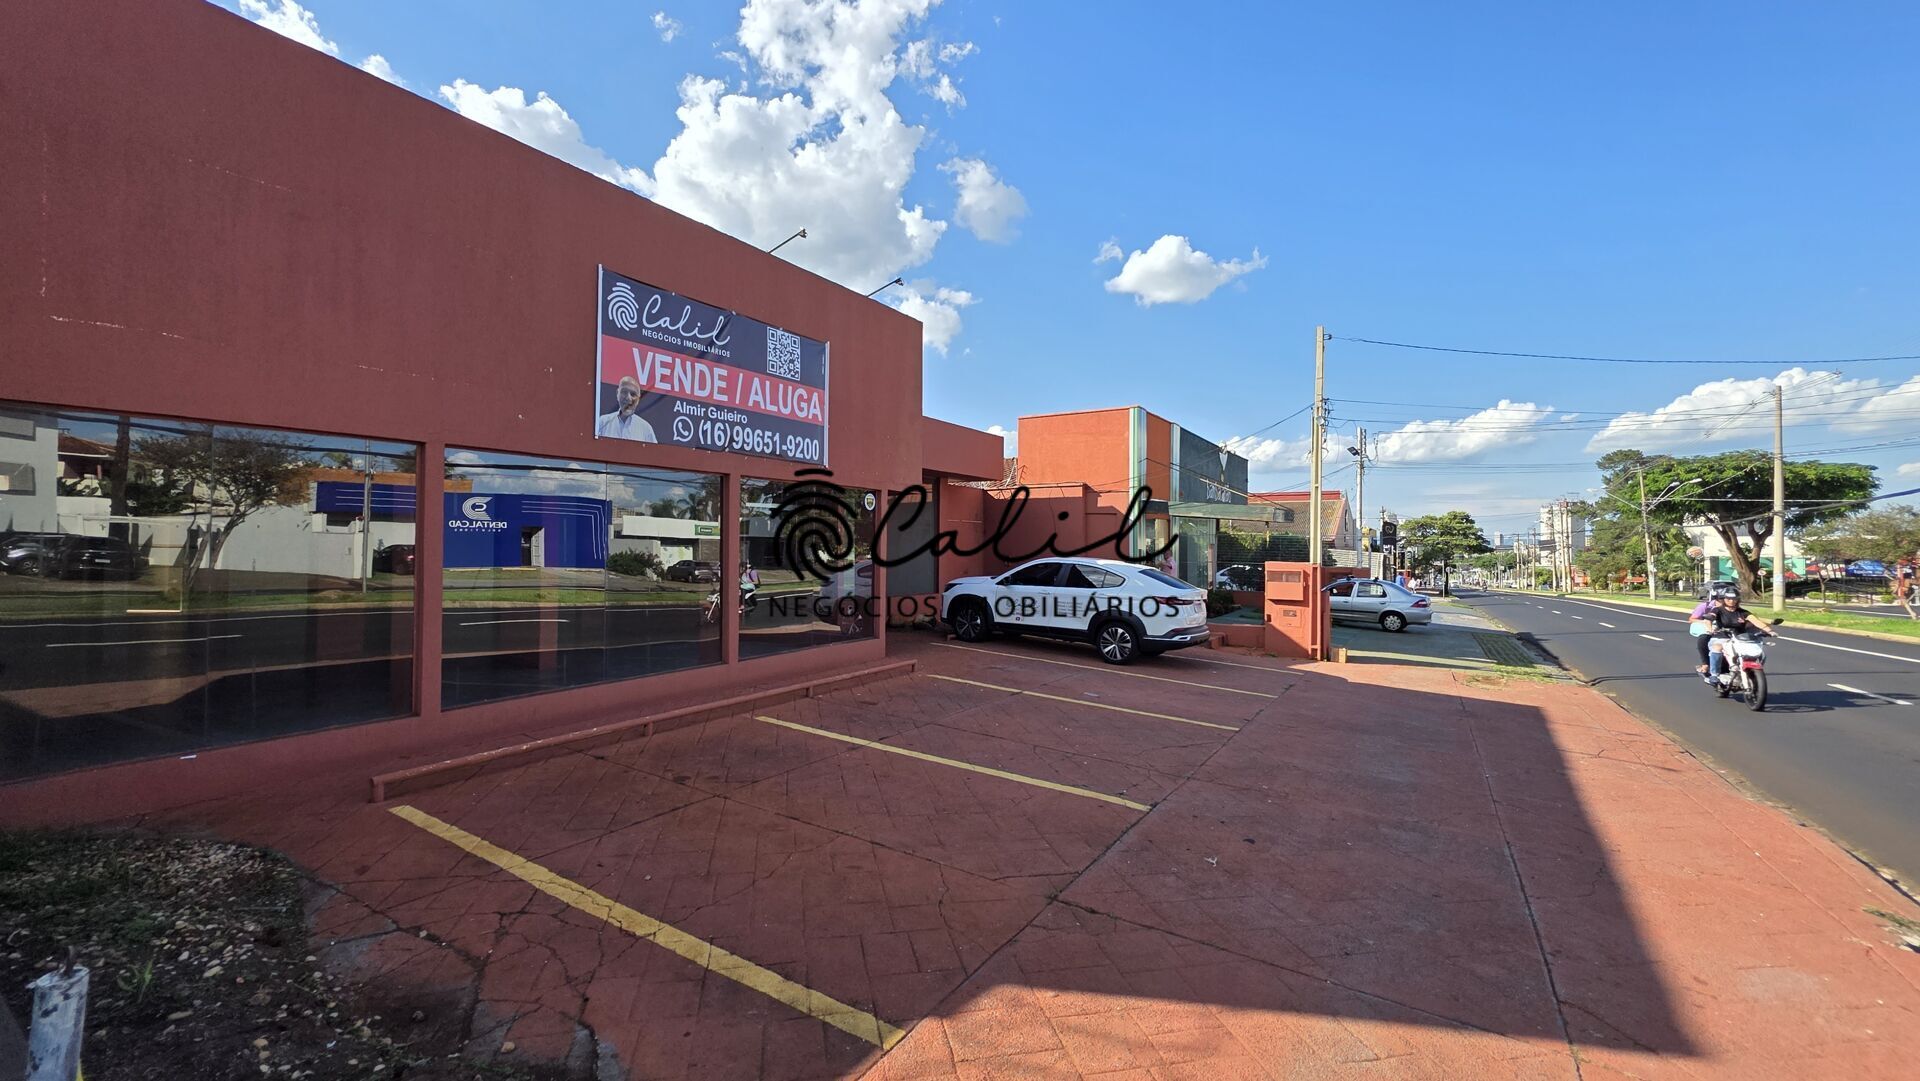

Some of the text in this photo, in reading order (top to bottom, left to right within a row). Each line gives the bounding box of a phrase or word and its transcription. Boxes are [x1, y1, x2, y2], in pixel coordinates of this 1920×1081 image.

[643, 295, 730, 345] Calil
[642, 329, 730, 358] NEGÓCIOS IMOBILIÁRIOS
[632, 348, 823, 422] VENDE / ALUGA
[674, 400, 748, 424] Almir Guieiro
